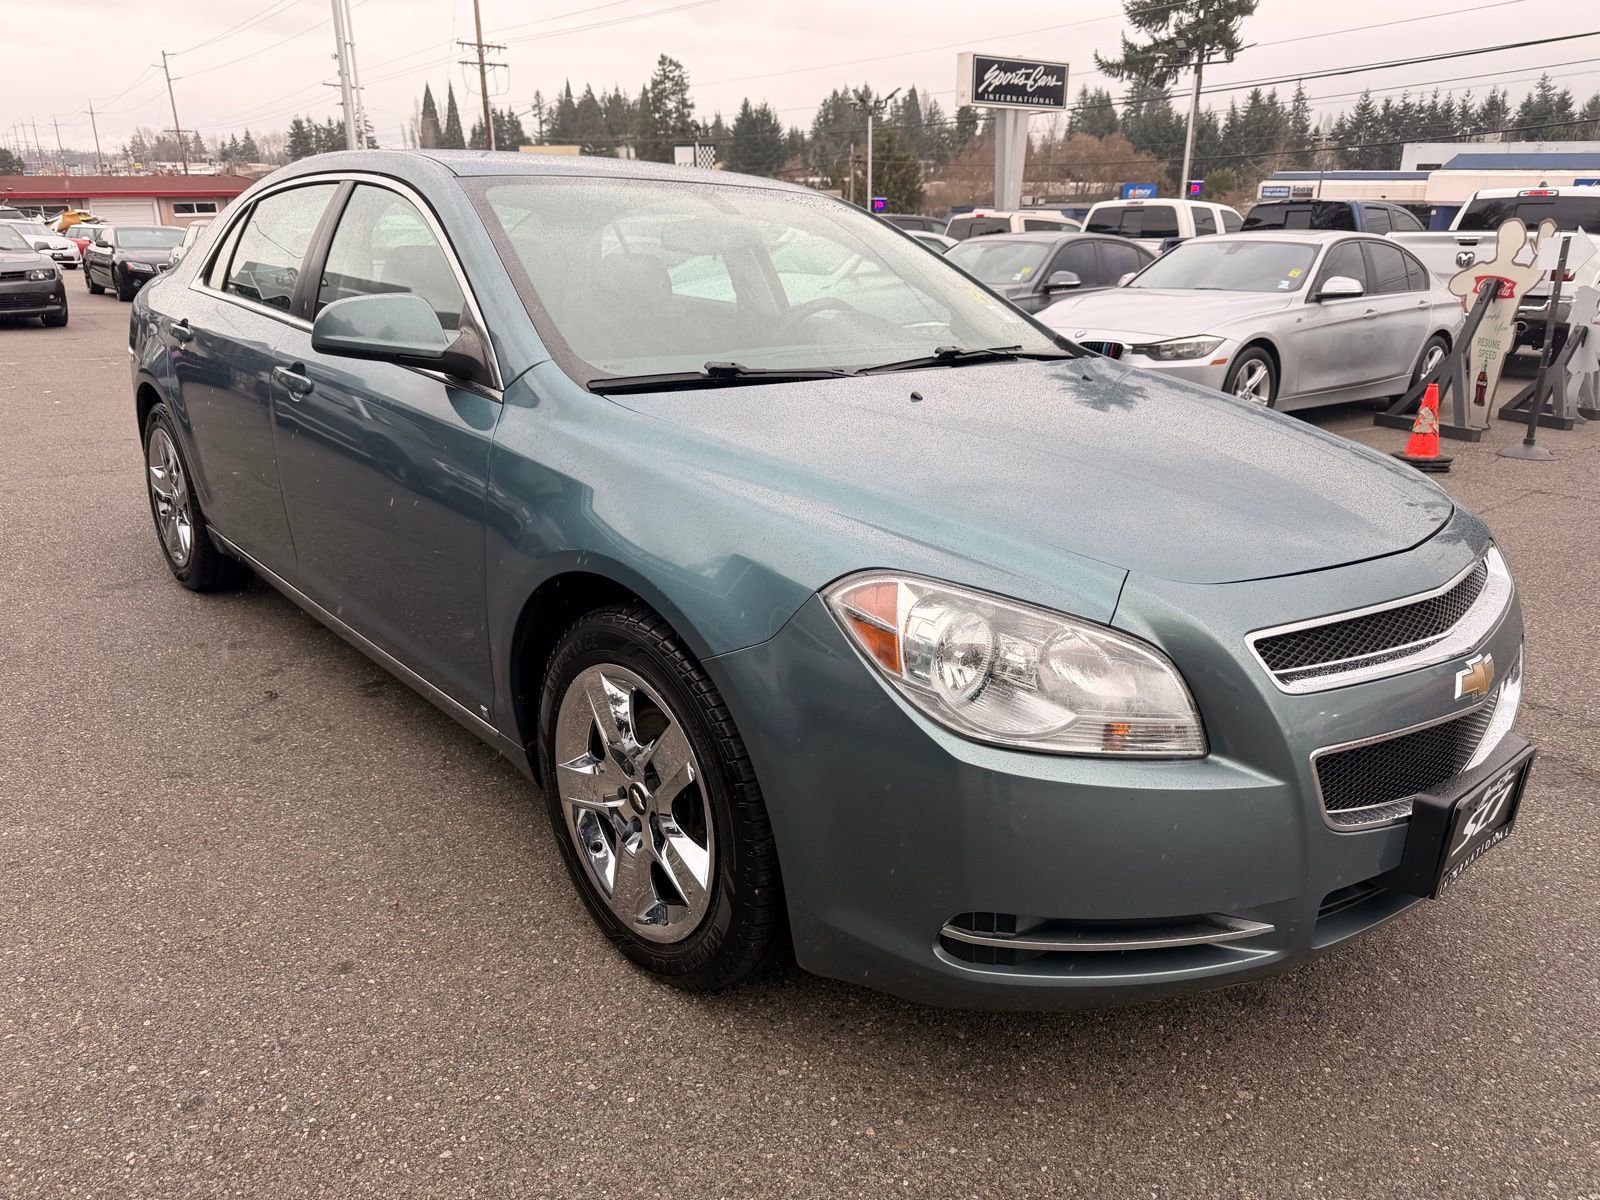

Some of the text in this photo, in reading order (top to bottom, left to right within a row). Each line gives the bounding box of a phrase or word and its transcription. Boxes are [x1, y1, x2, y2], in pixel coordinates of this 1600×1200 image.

[978, 63, 1062, 93] Sports Cars
[984, 94, 1055, 105] INTERNATIONAL
[1477, 337, 1501, 350] RESUME
[1478, 348, 1497, 360] SPEED
